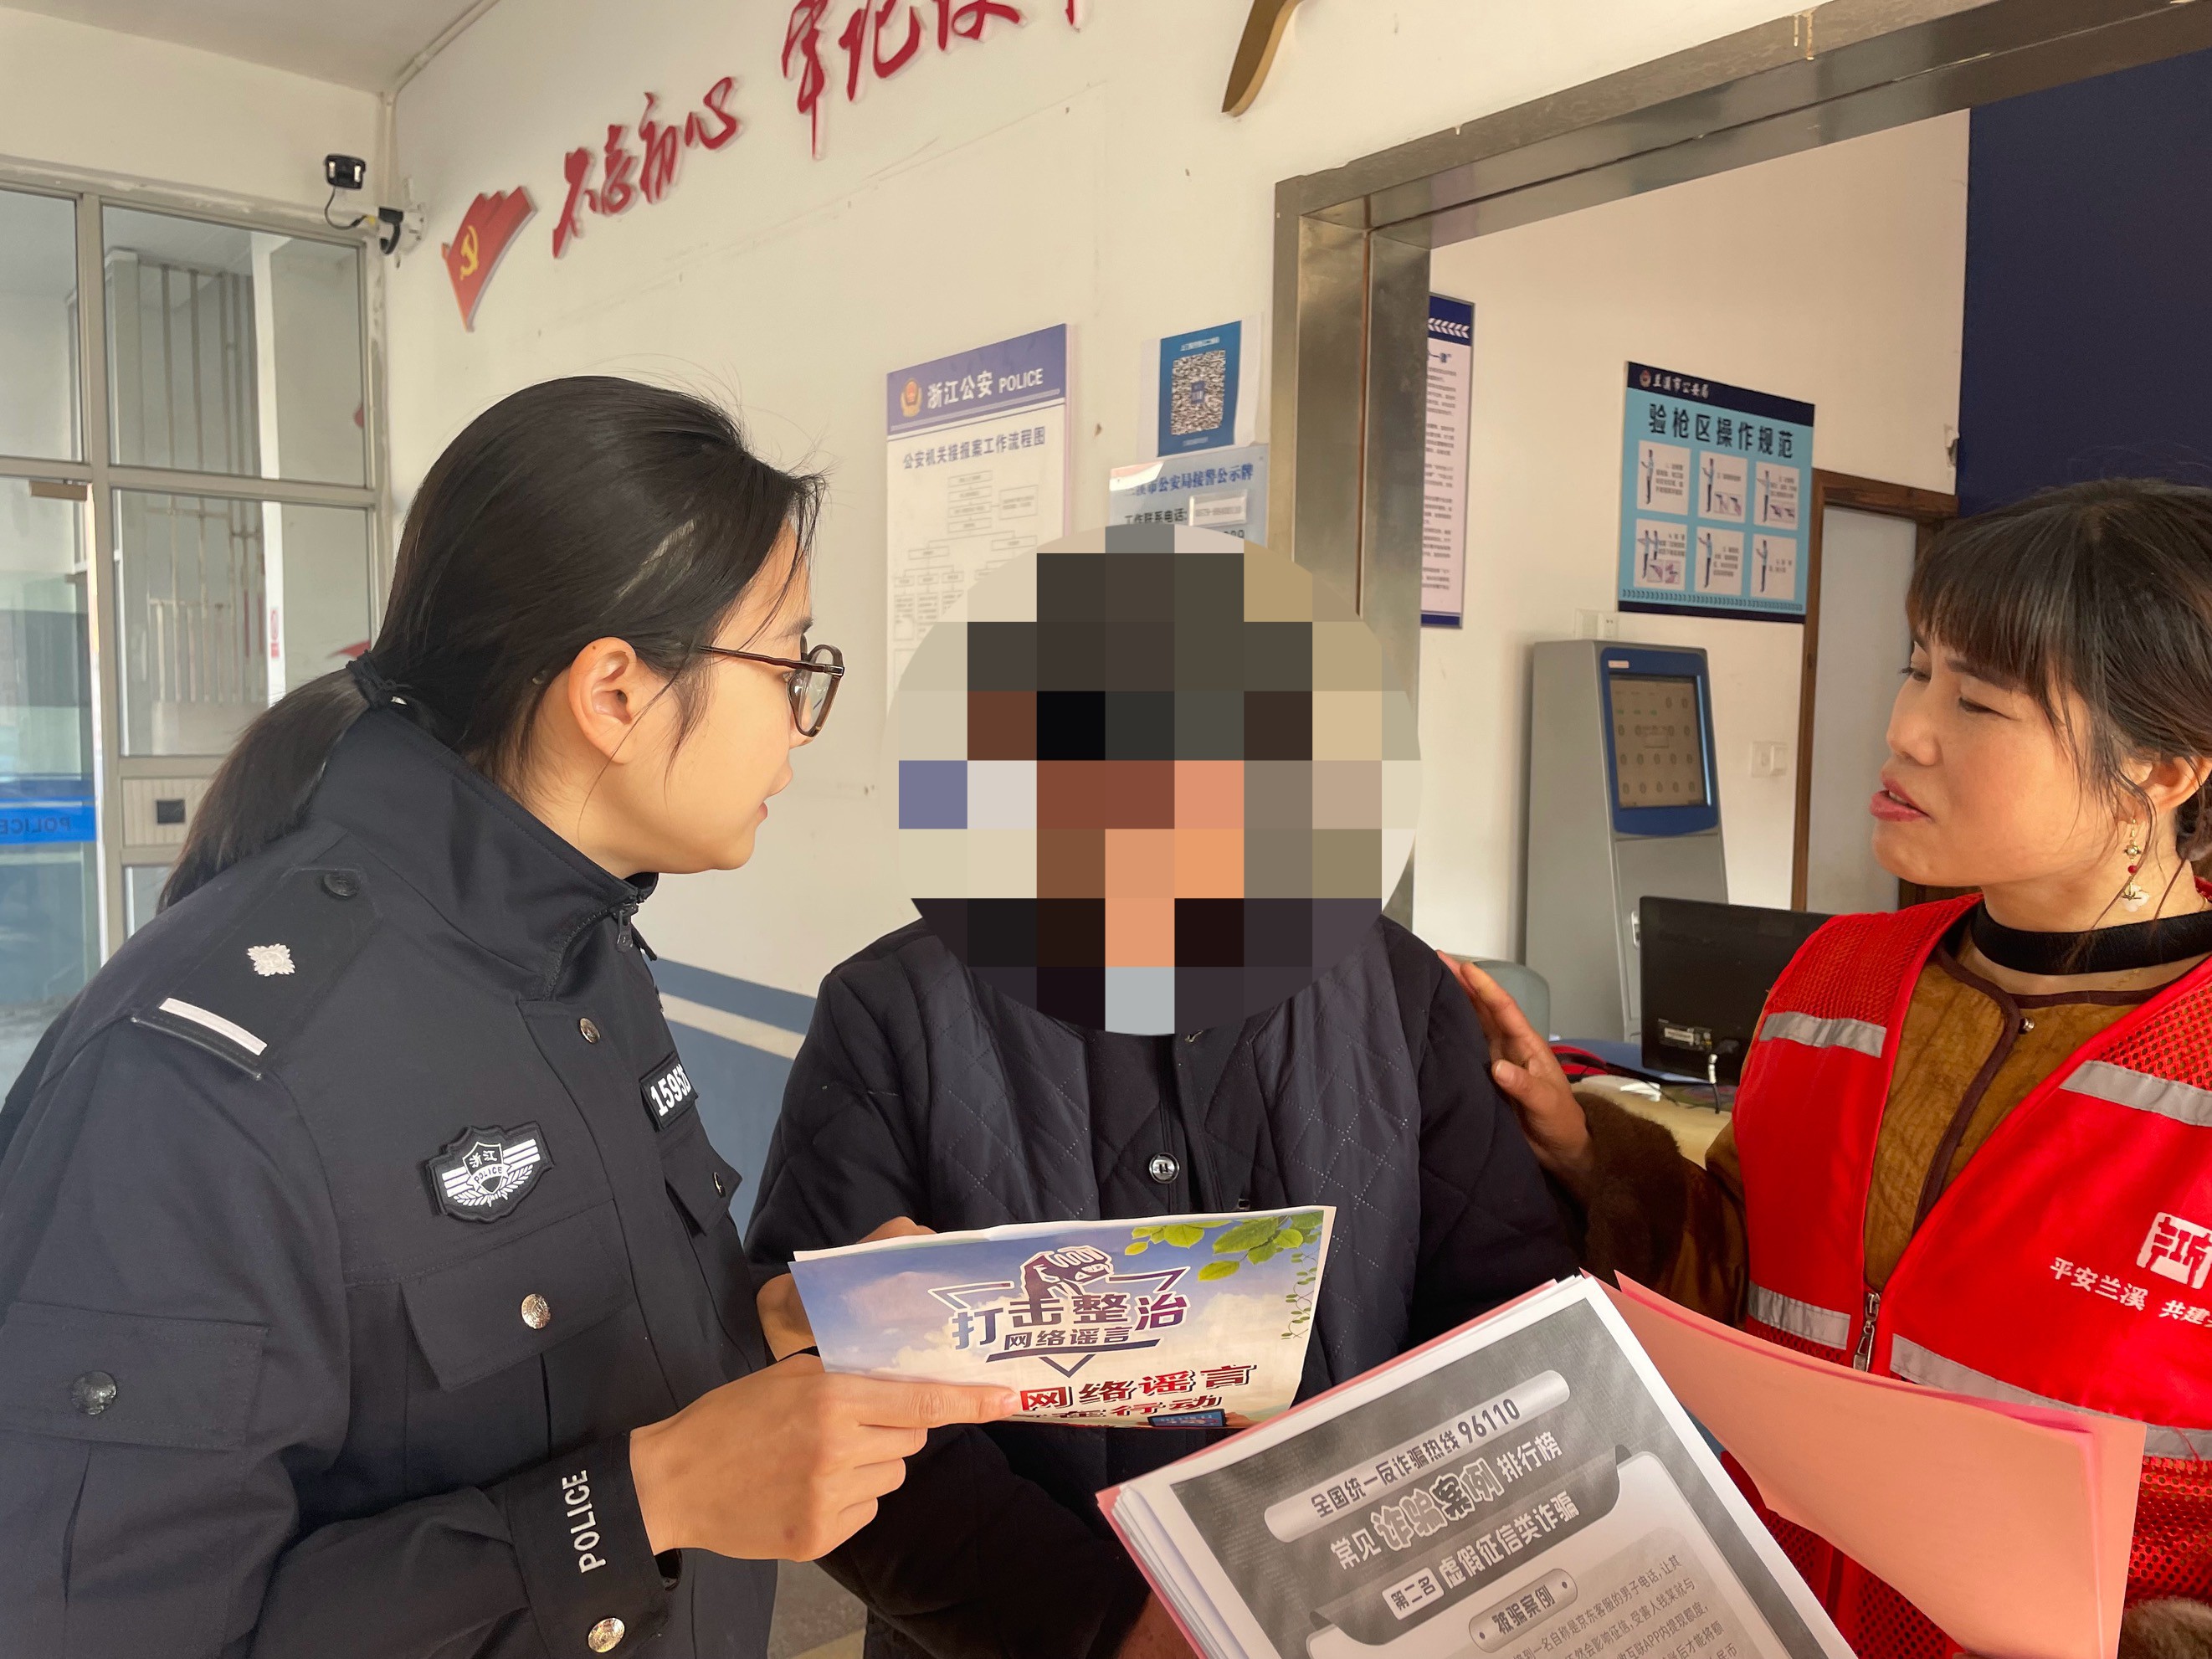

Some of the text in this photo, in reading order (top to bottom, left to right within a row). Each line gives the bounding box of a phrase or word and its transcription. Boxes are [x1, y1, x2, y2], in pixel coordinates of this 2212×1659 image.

[926, 368, 1044, 409] 浙江公安 POLICE
[903, 426, 1045, 470] 公安机关接报案工作流程图
[1649, 403, 1793, 459] 验枪区操作规范
[474, 1166, 502, 1184] POLICE
[2050, 1256, 2212, 1328] 平安兰溪 共建
[952, 1292, 1188, 1350] 打击整治
[1003, 1326, 1133, 1351] 网络谣言
[1019, 1364, 1258, 1412] 网络谣言
[1311, 1398, 1521, 1518] 全国统一反诈骗热线 96110
[562, 1470, 607, 1574] POLICE
[1390, 1491, 1580, 1610] 第二名 虚假征信类诈骗
[1491, 1584, 1556, 1636] 被骗案例
